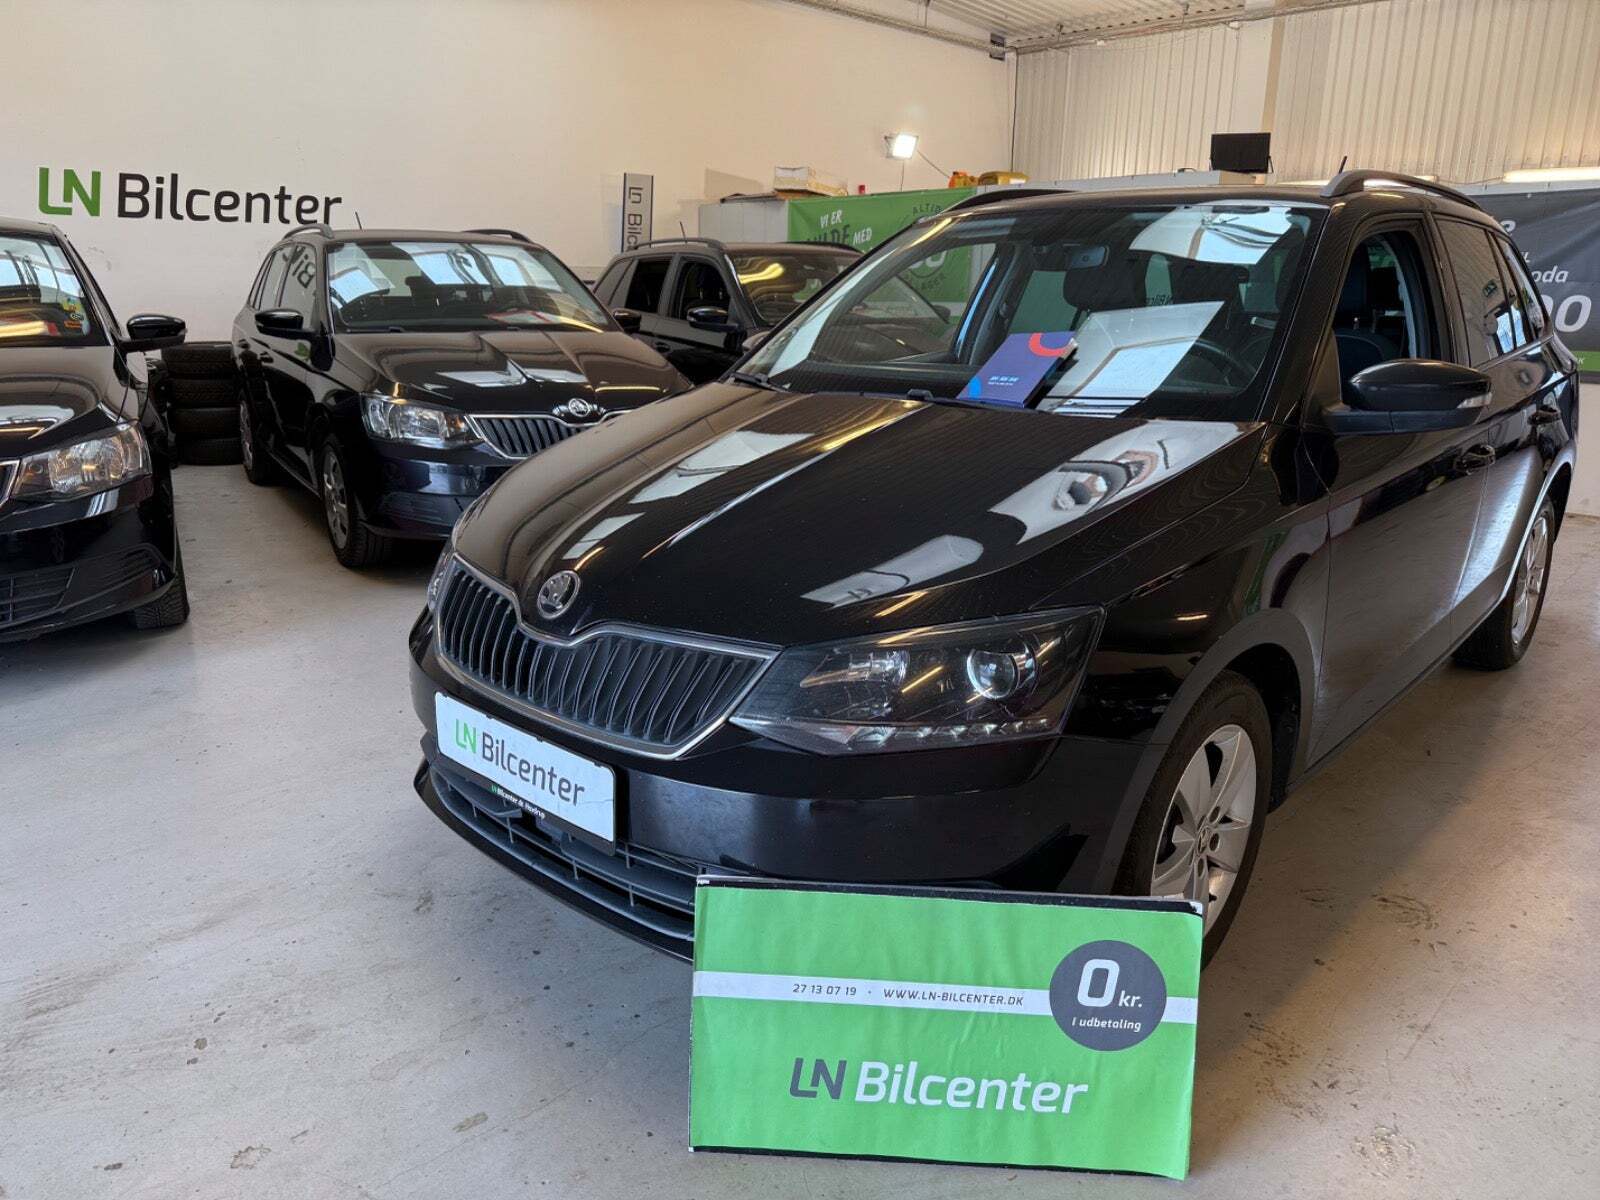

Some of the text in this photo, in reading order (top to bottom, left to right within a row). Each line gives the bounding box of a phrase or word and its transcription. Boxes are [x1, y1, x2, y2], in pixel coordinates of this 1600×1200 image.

[38, 167, 343, 225] LN Bilcenter
[831, 209, 843, 225] ER
[852, 227, 873, 246] MED
[1532, 265, 1569, 284] oda
[455, 718, 586, 807] LN Bilcenter
[793, 983, 1024, 1006] 27 13 07 19 WWW.LN-BILCENTER.DK
[1077, 959, 1143, 1008] 0 kr.
[1079, 1017, 1142, 1033] udbetaling
[789, 1057, 1088, 1114] LN Bilcenter
